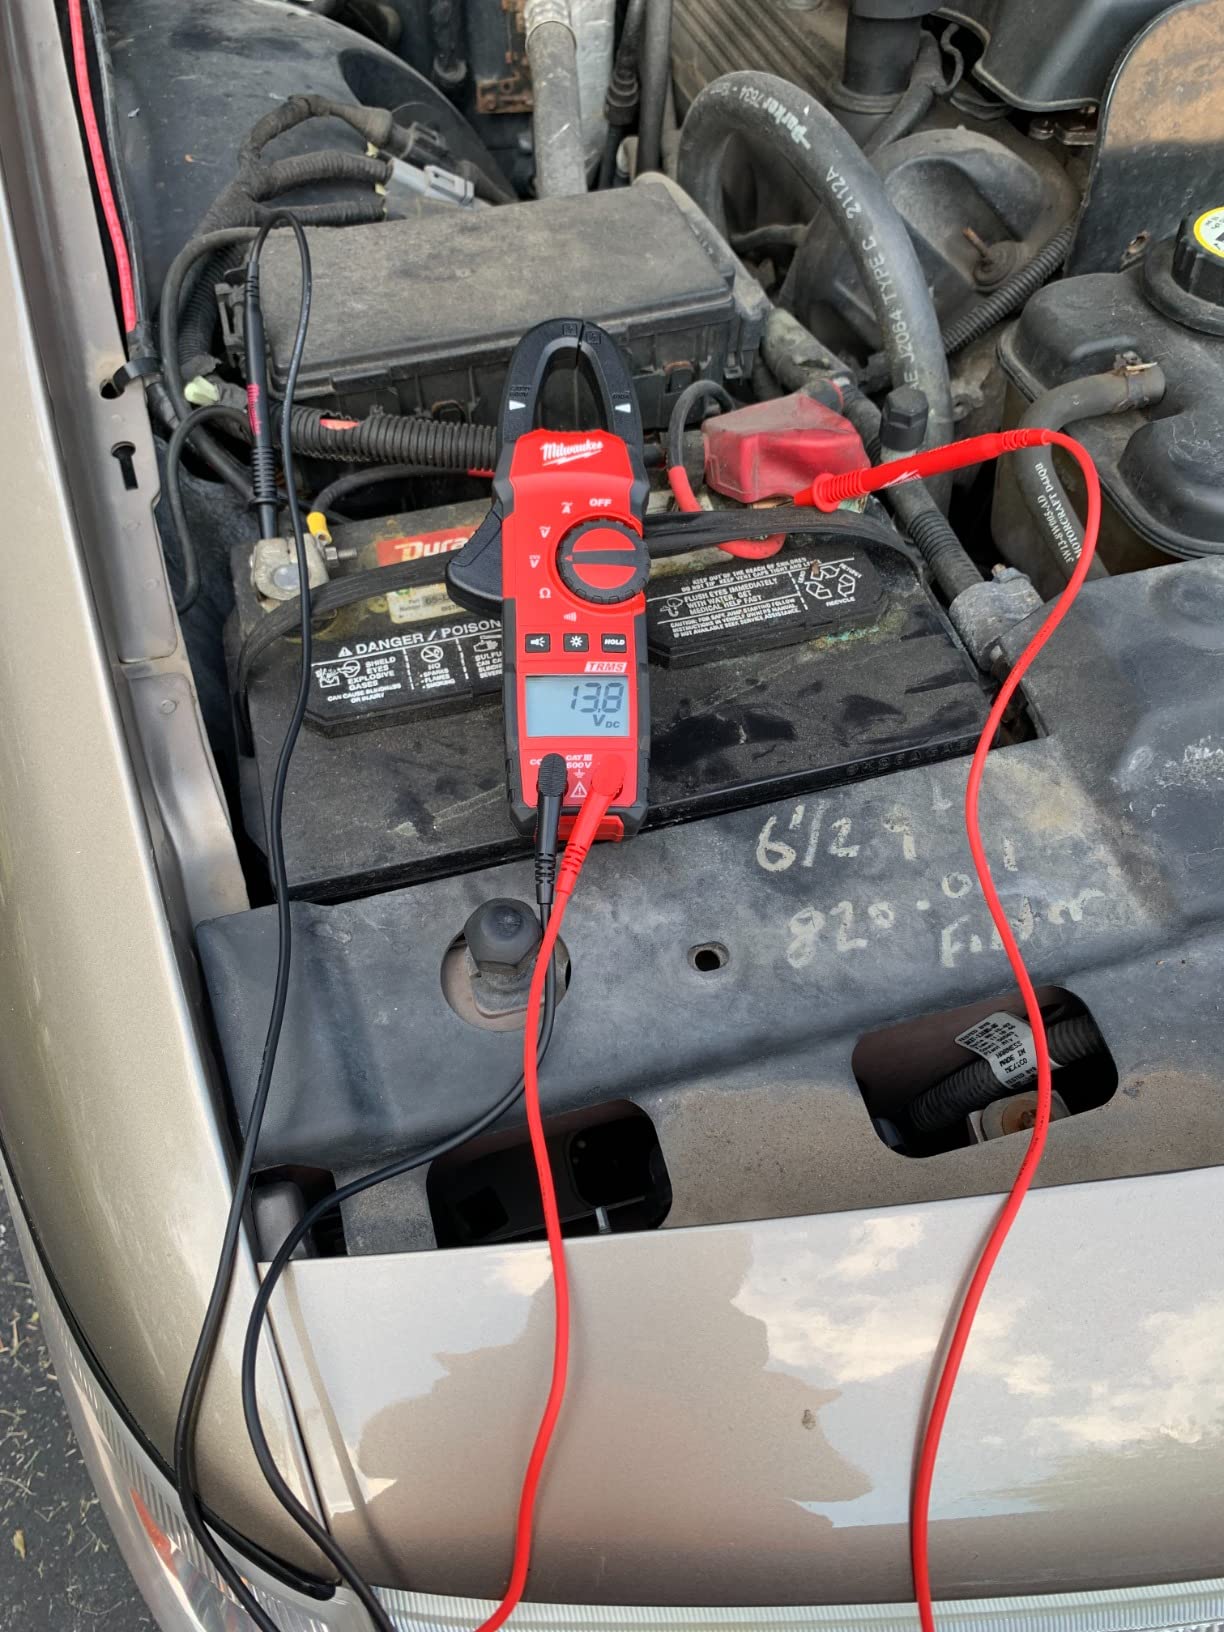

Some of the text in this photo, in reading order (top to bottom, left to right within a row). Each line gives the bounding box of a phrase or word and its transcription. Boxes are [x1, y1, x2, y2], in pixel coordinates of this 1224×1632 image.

[826, 166, 862, 219] 2112A
[869, 253, 897, 305] TYPE
[904, 369, 919, 390] AE
[540, 439, 604, 461] Milwaukee
[589, 498, 612, 507] OFF
[1048, 492, 1083, 559] MOTORCRAFT
[683, 577, 777, 602] FLUSH EYES IMMEDIATELY
[686, 600, 706, 609] WITH
[737, 590, 751, 598] GET
[689, 603, 722, 615] MEDICAL
[723, 599, 742, 608] HELP
[825, 596, 856, 608] RECYCLE
[355, 633, 424, 655] DANGER
[441, 619, 502, 638] POISON
[604, 638, 625, 646] HOLD
[364, 656, 396, 668] SHIELD
[427, 662, 441, 670] NO
[586, 662, 625, 672] TRMS
[347, 670, 395, 684] EXPLOSIVE
[366, 665, 389, 675] EYES
[349, 679, 379, 691] GASES
[570, 682, 624, 713] 13.8
[998, 1054, 1014, 1067] MADE
